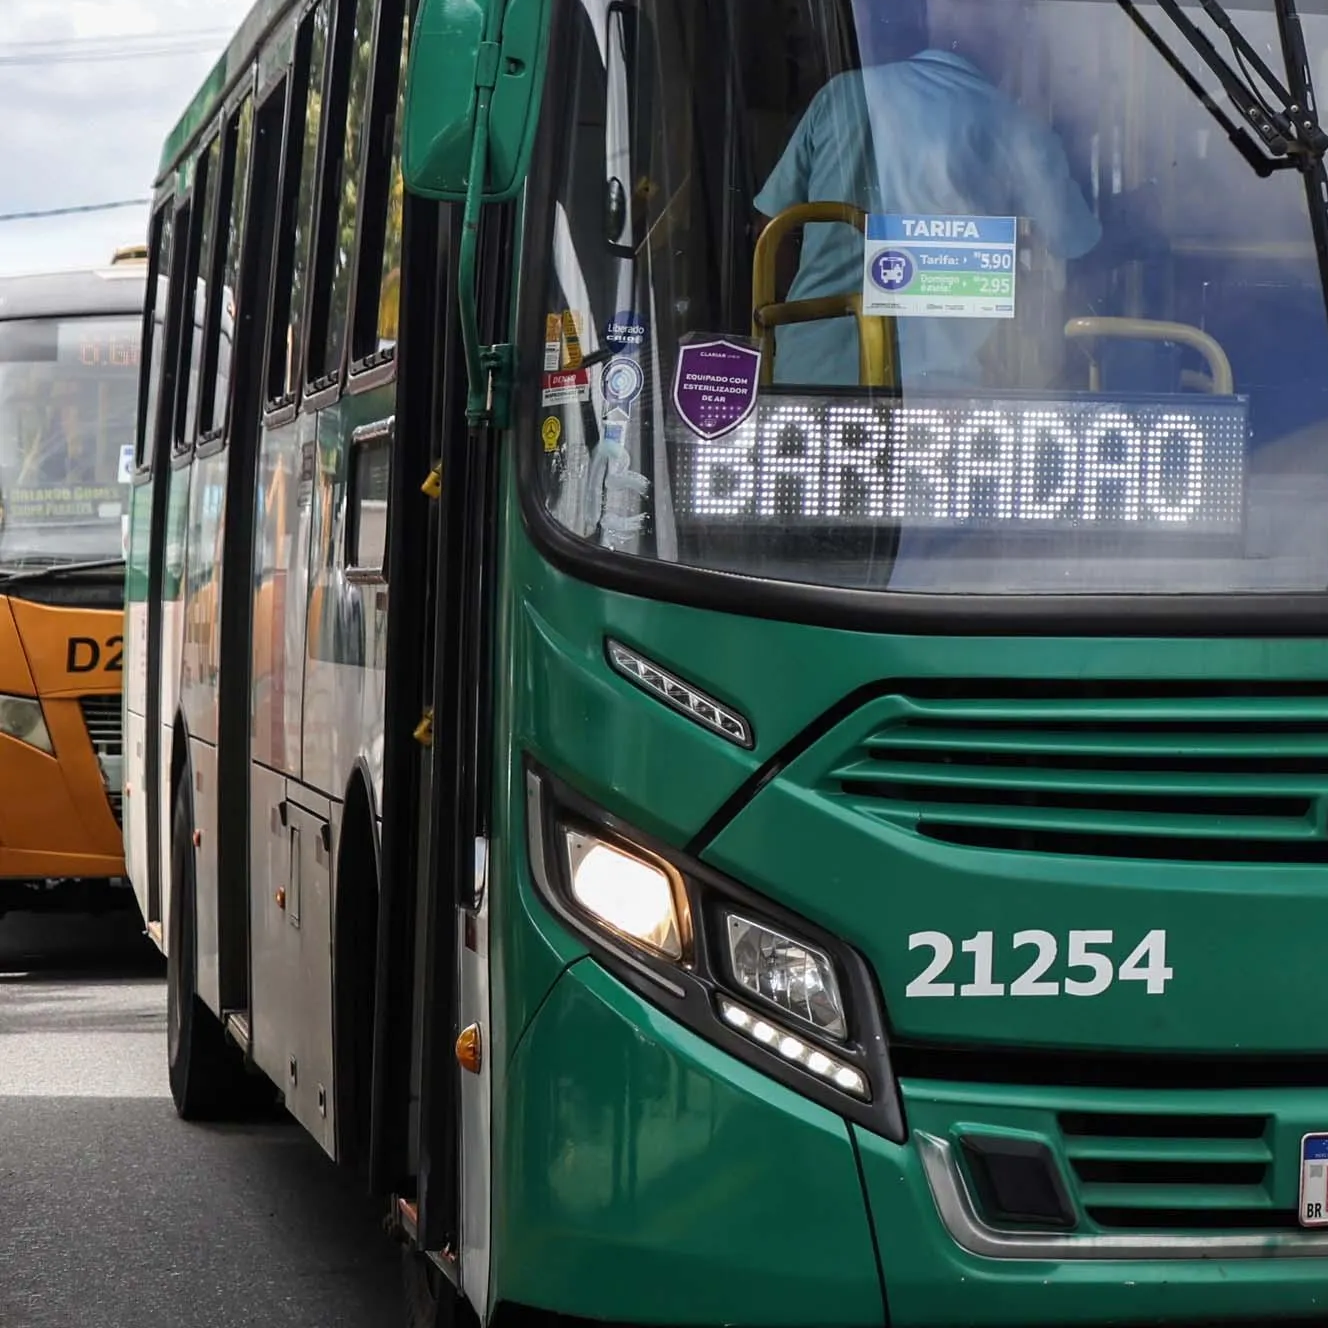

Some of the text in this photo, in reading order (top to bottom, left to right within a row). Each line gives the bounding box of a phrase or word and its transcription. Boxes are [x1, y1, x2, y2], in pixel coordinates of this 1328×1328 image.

[902, 219, 980, 239] TARIFA
[920, 254, 959, 265] Tarifa:
[607, 323, 645, 334] Liberado
[686, 374, 748, 385] EQUIPADO COM
[683, 383, 748, 394] ESTERILIZADOR
[714, 395, 726, 403] AR
[905, 929, 1174, 998] 21254
[1307, 1203, 1322, 1218] BR
